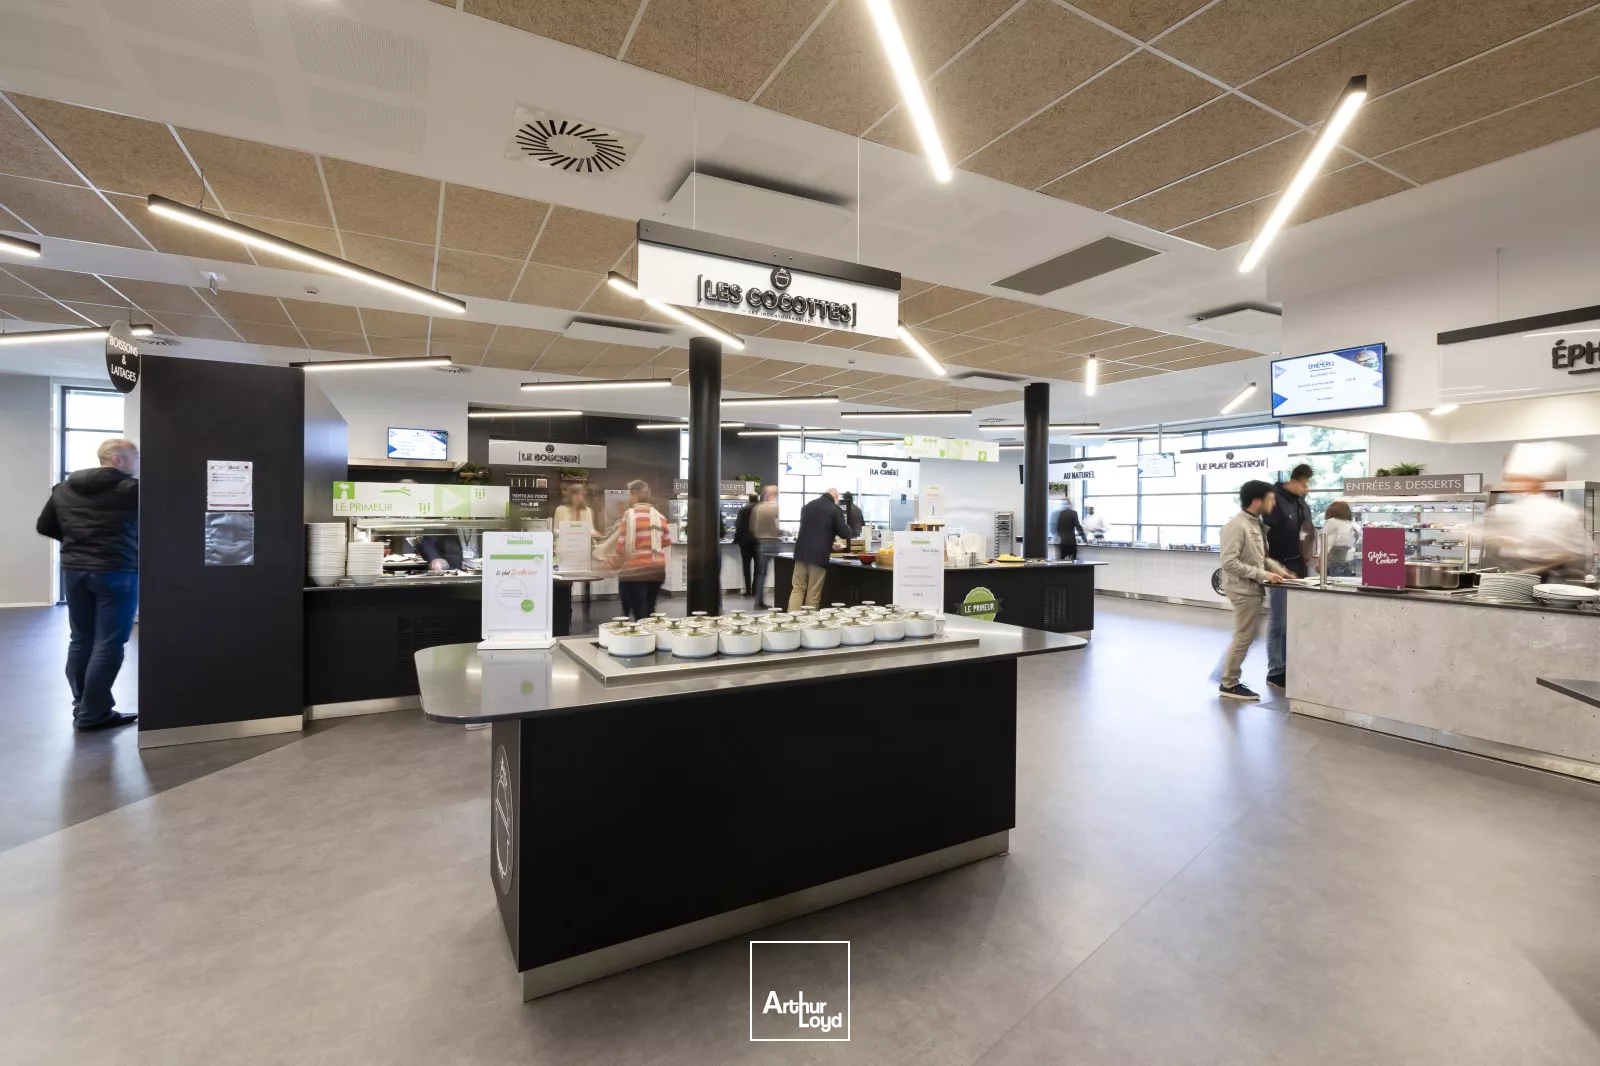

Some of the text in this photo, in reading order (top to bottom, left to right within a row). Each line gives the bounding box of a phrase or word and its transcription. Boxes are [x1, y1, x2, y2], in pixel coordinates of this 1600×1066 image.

[109, 336, 138, 357] BOISSONS
[121, 355, 127, 365] &
[111, 364, 137, 382] LAITAGES
[1063, 471, 1096, 480] AU NATUREL
[720, 483, 745, 491] ESSERTS
[1346, 479, 1461, 491] ENTRÉES & DESSERTS
[335, 502, 393, 512] LE PRIMEUR
[1368, 551, 1388, 562] Globe
[1376, 557, 1399, 565] Cooker
[964, 603, 995, 613] LE PRIMEUR
